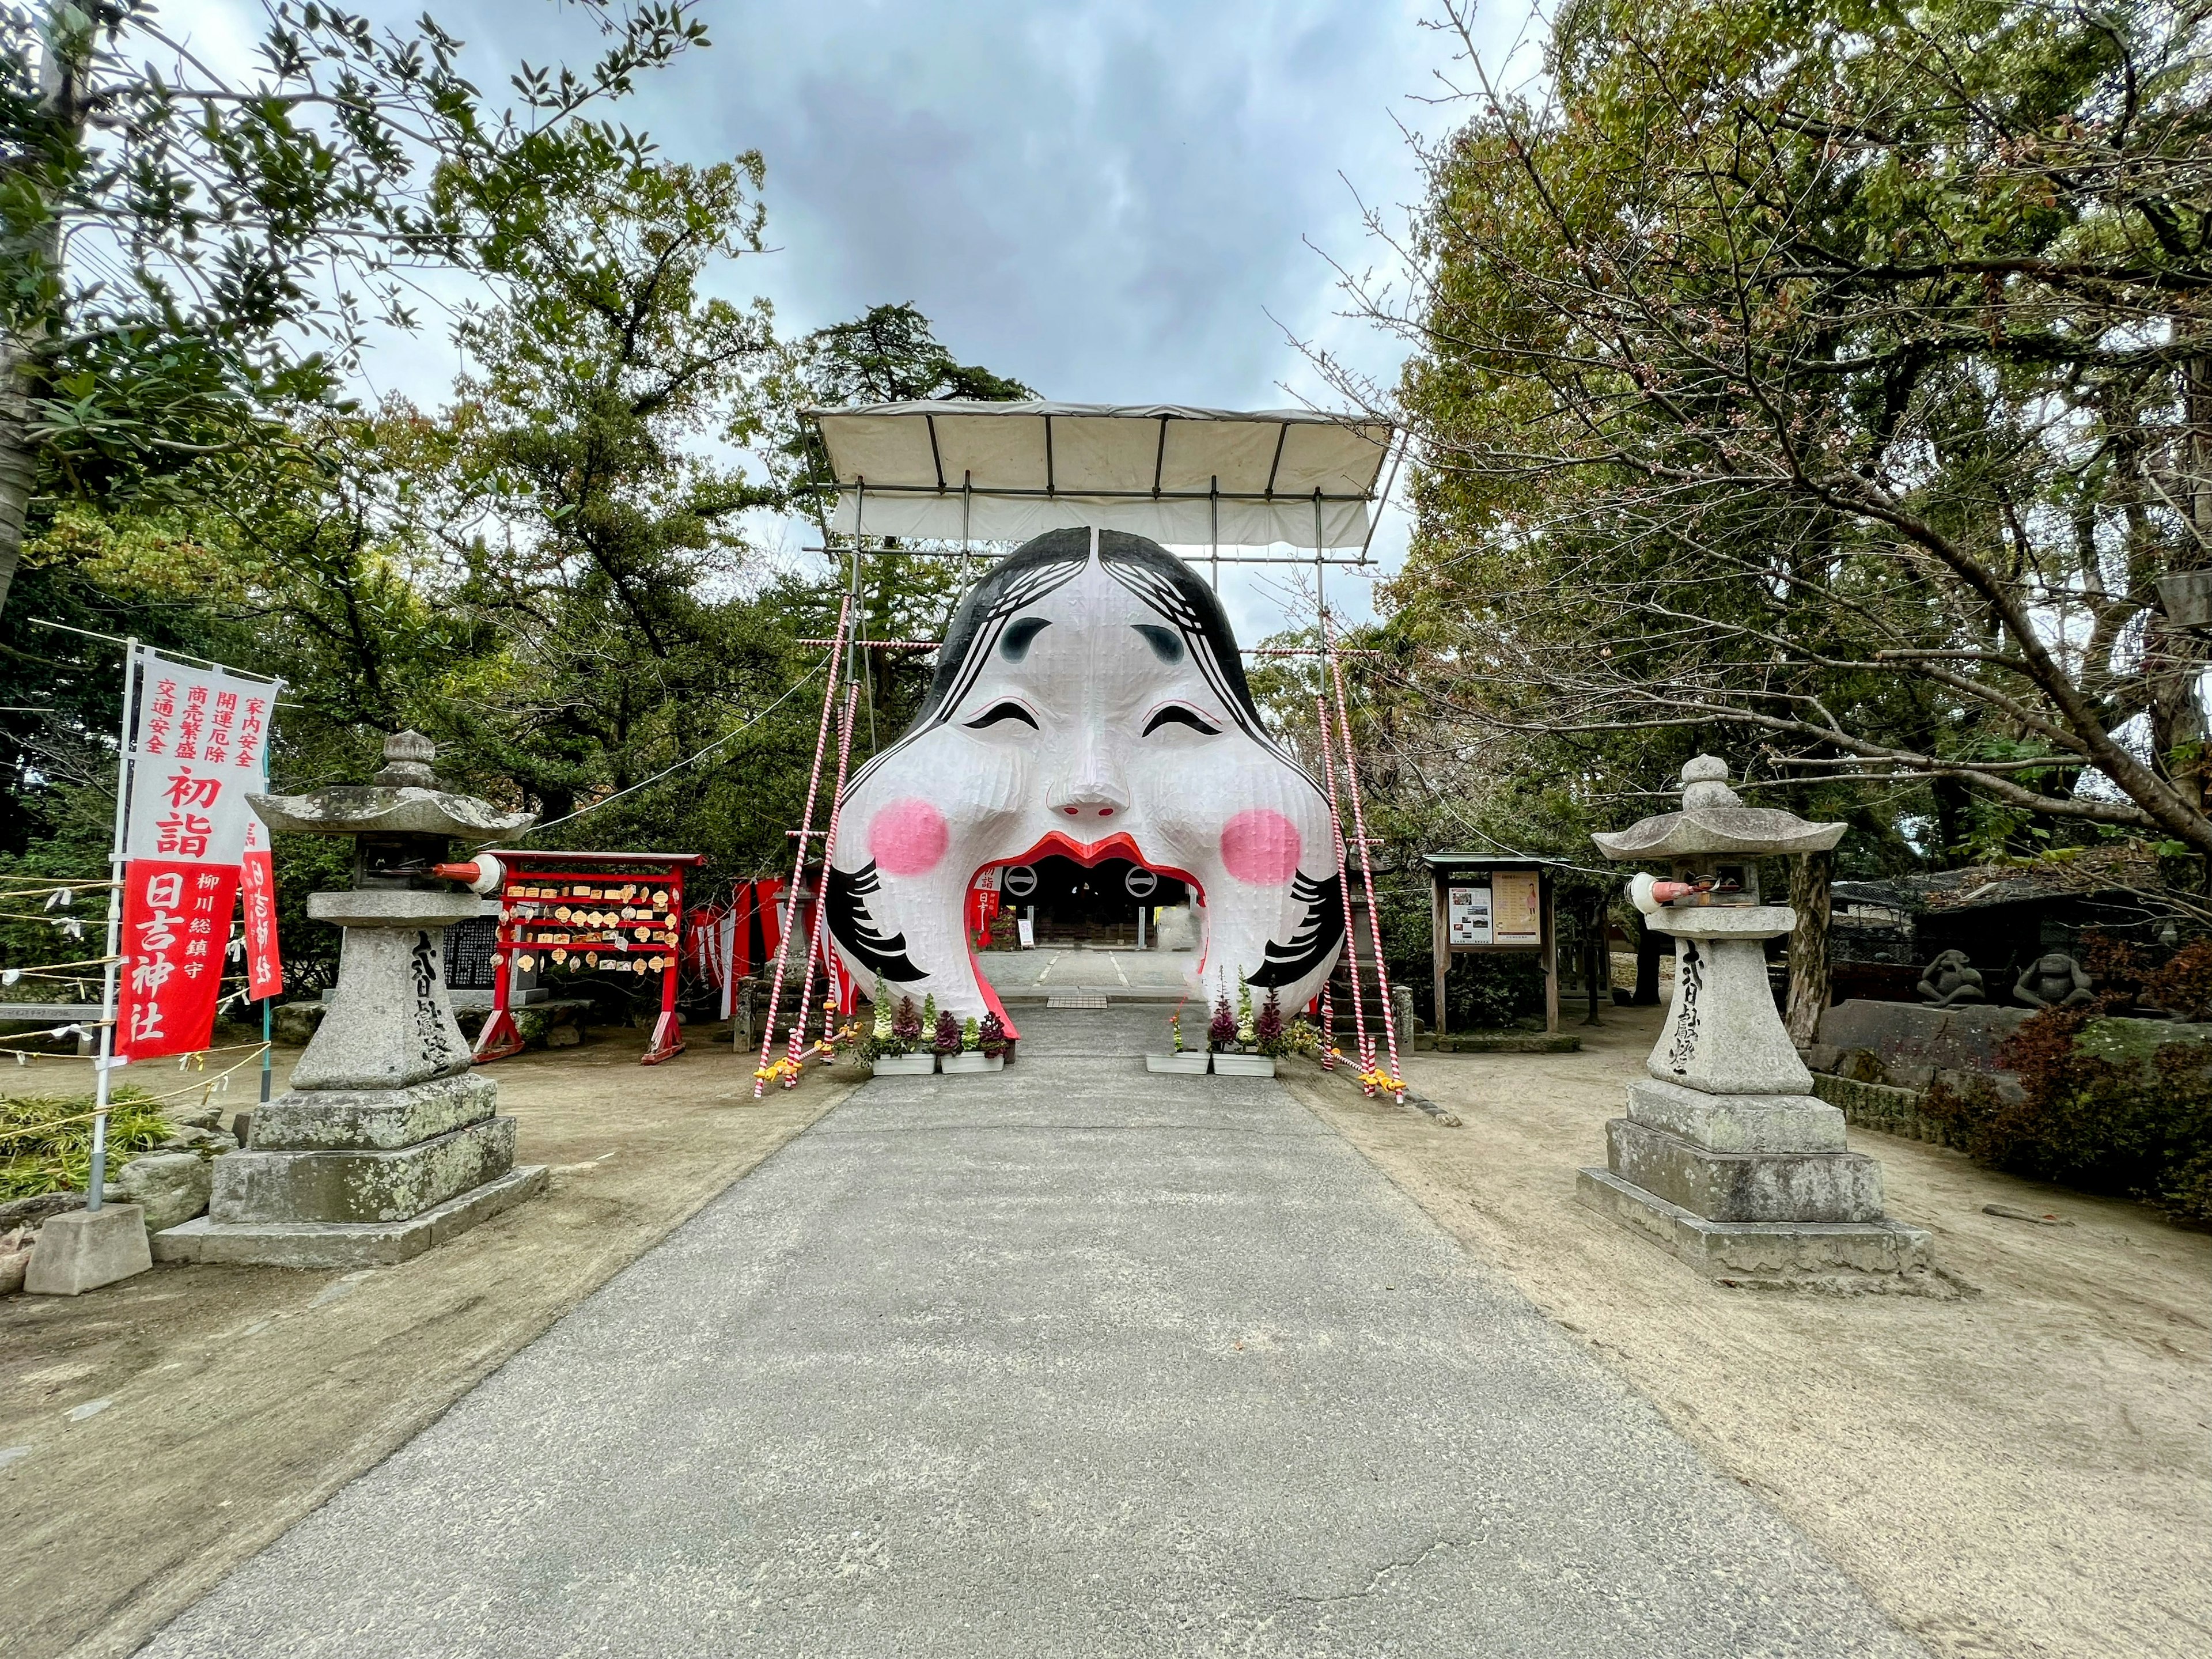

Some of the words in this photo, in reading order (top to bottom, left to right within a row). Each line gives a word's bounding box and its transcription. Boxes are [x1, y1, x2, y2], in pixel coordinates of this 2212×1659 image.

[145, 678, 177, 755] 交通安全
[175, 685, 209, 759] 商売繁盛
[204, 691, 237, 763] 開運厄除
[234, 697, 266, 768] 家内安全
[156, 765, 222, 858] 初詣
[131, 872, 185, 1043] 日吉神社
[183, 872, 219, 979] 柳川総鎮守
